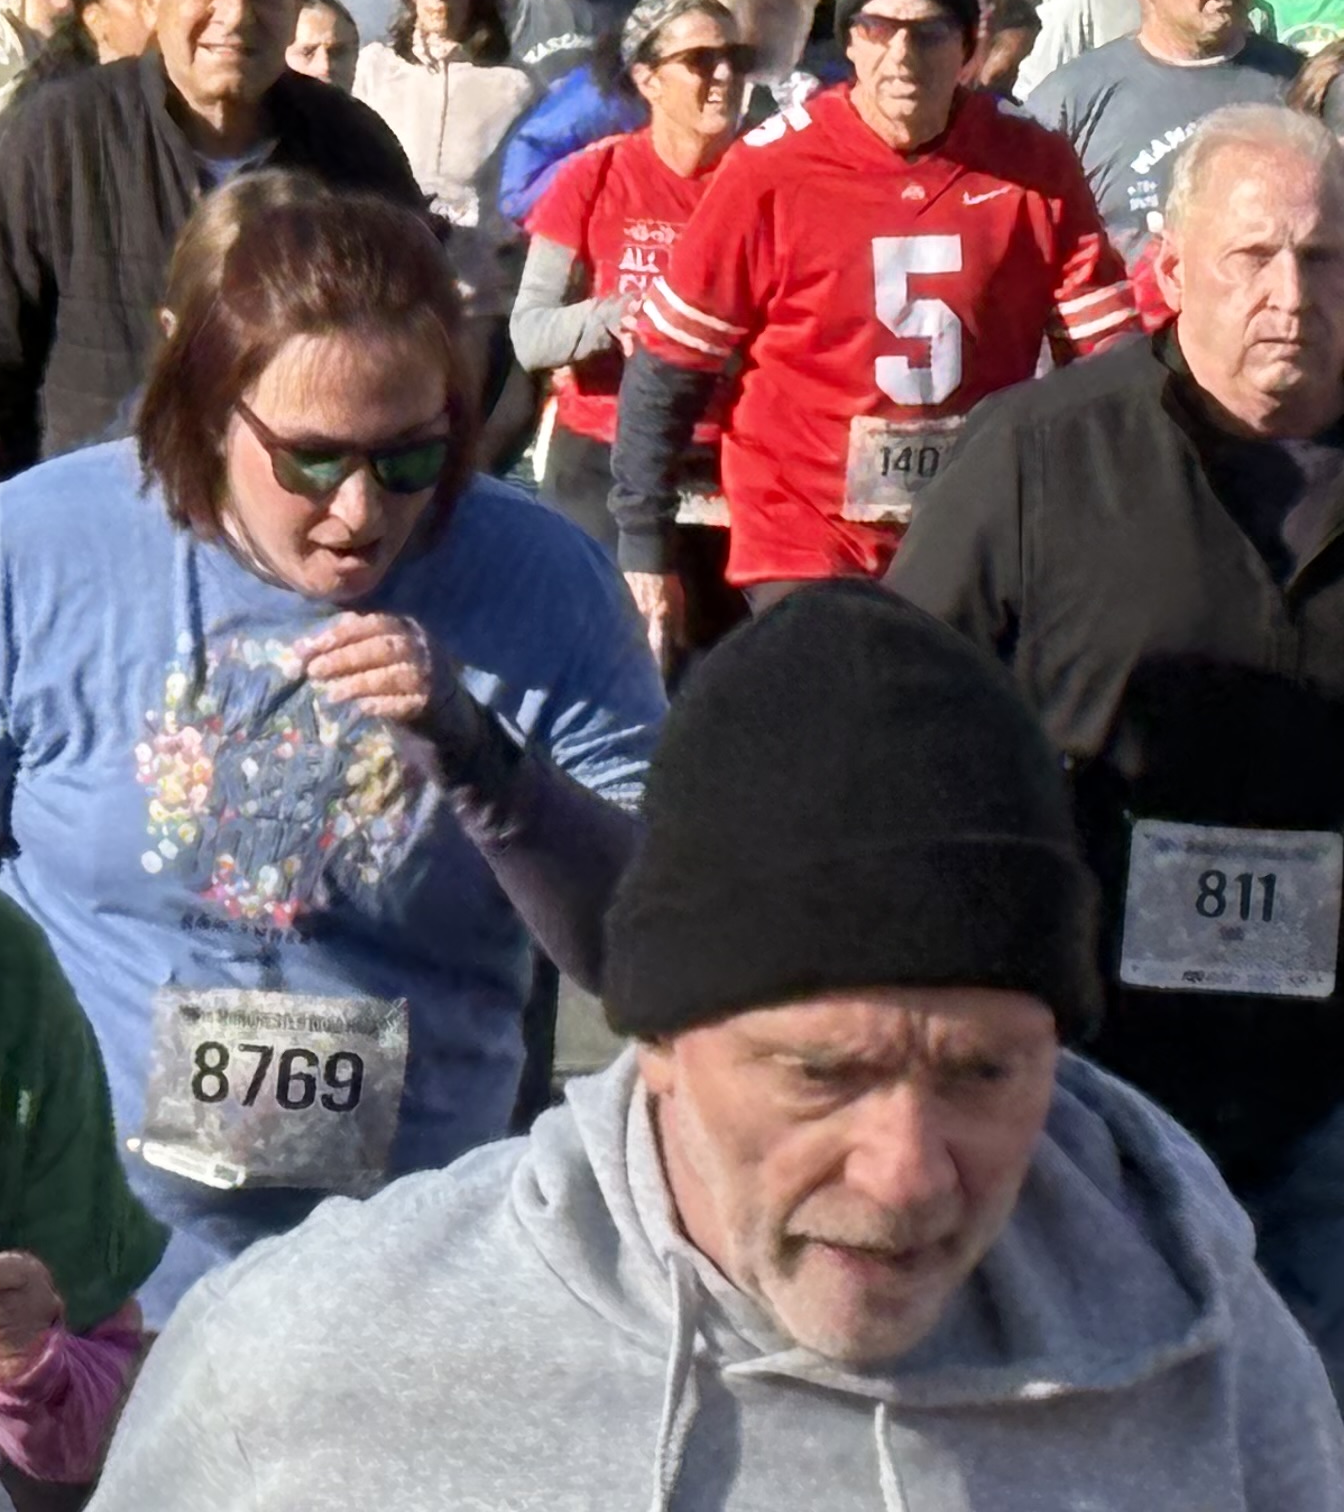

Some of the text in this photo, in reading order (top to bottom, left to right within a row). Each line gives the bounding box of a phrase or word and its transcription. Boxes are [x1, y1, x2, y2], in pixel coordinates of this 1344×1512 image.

[872, 235, 962, 405] 5
[1195, 869, 1277, 923] 811
[191, 1041, 364, 1112] 8769
